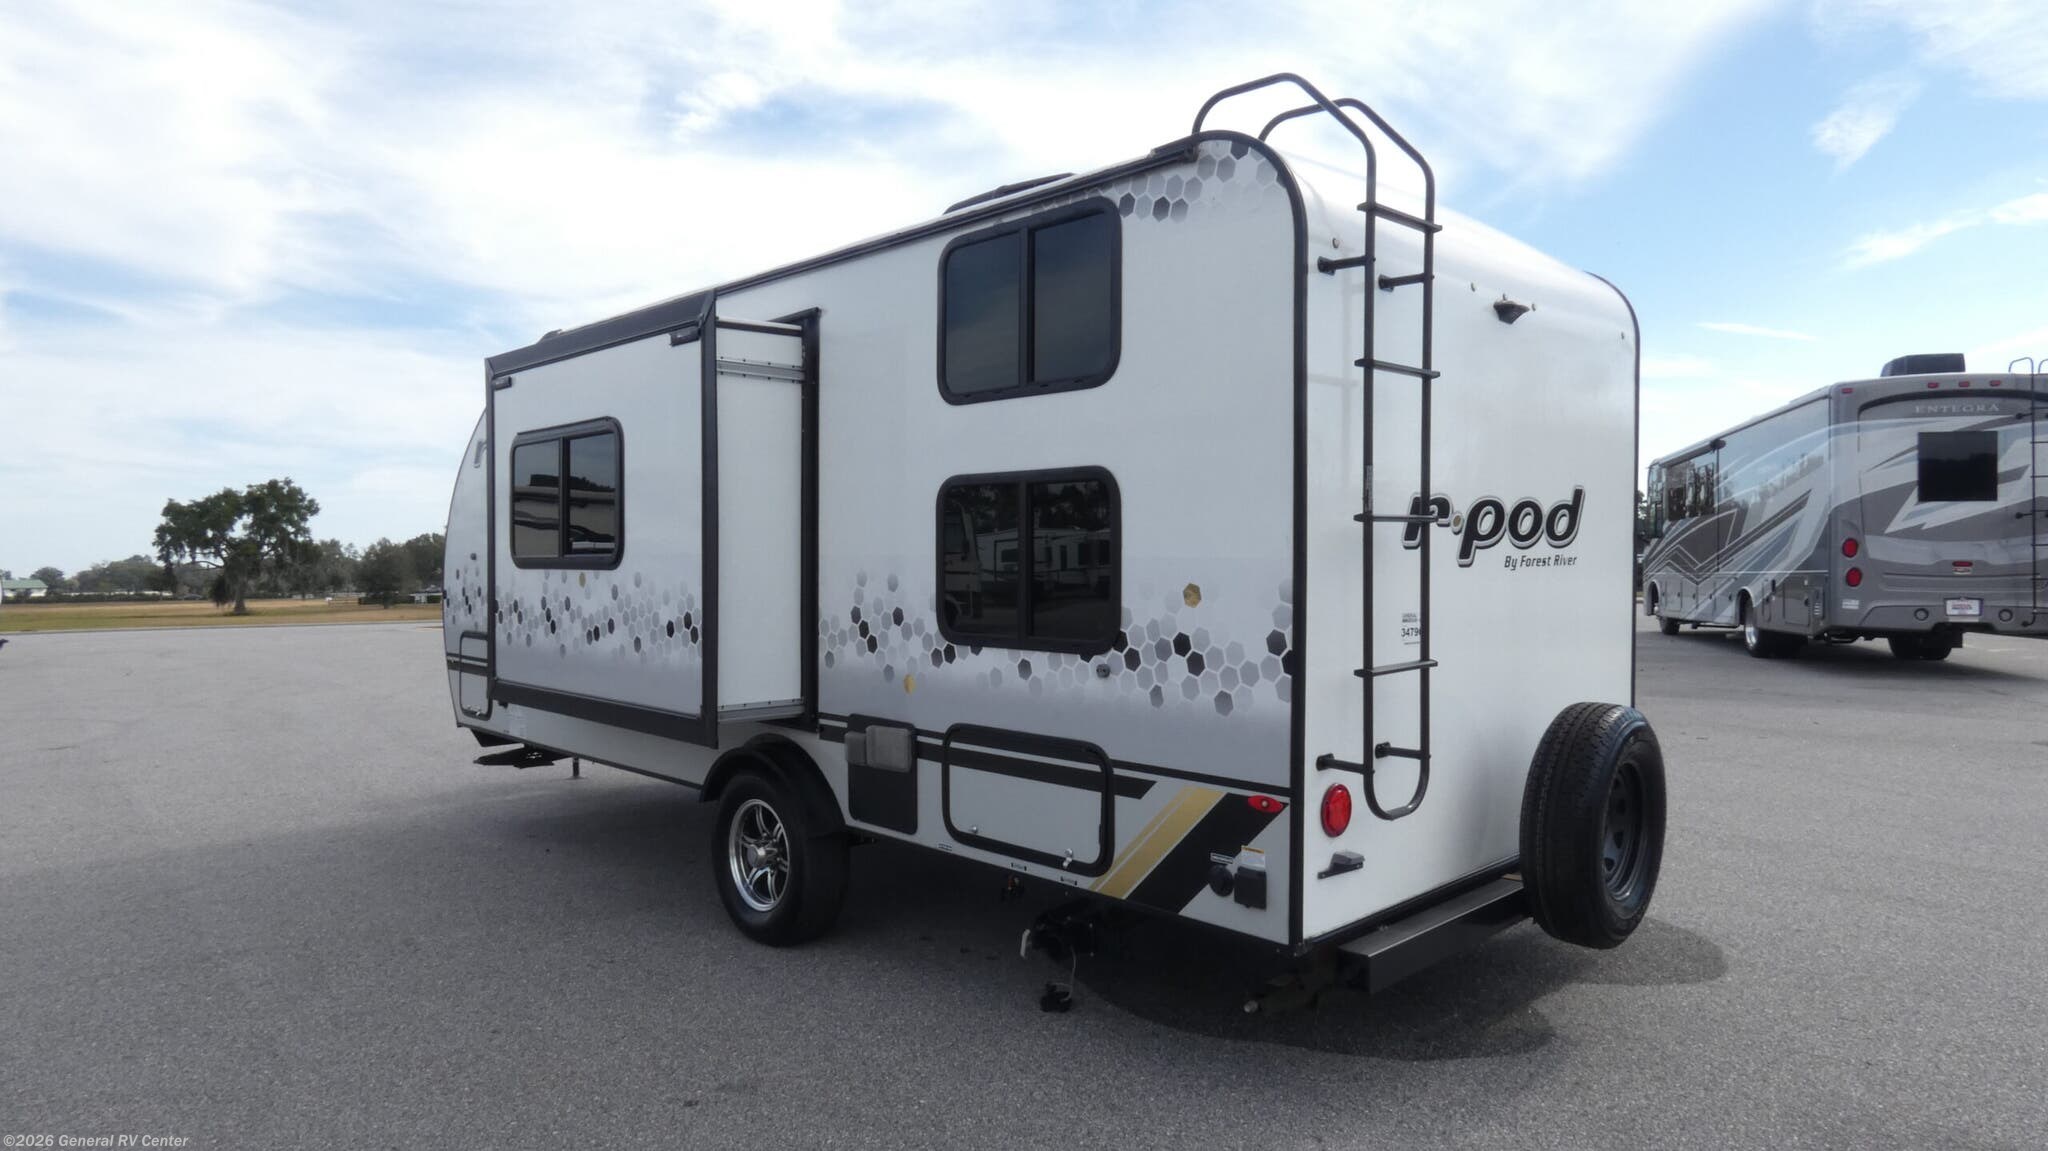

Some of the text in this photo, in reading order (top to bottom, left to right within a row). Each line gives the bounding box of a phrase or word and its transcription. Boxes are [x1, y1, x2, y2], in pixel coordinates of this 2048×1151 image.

[1915, 403, 2000, 414] ENTEGRA
[1504, 553, 1578, 571] By Forest River
